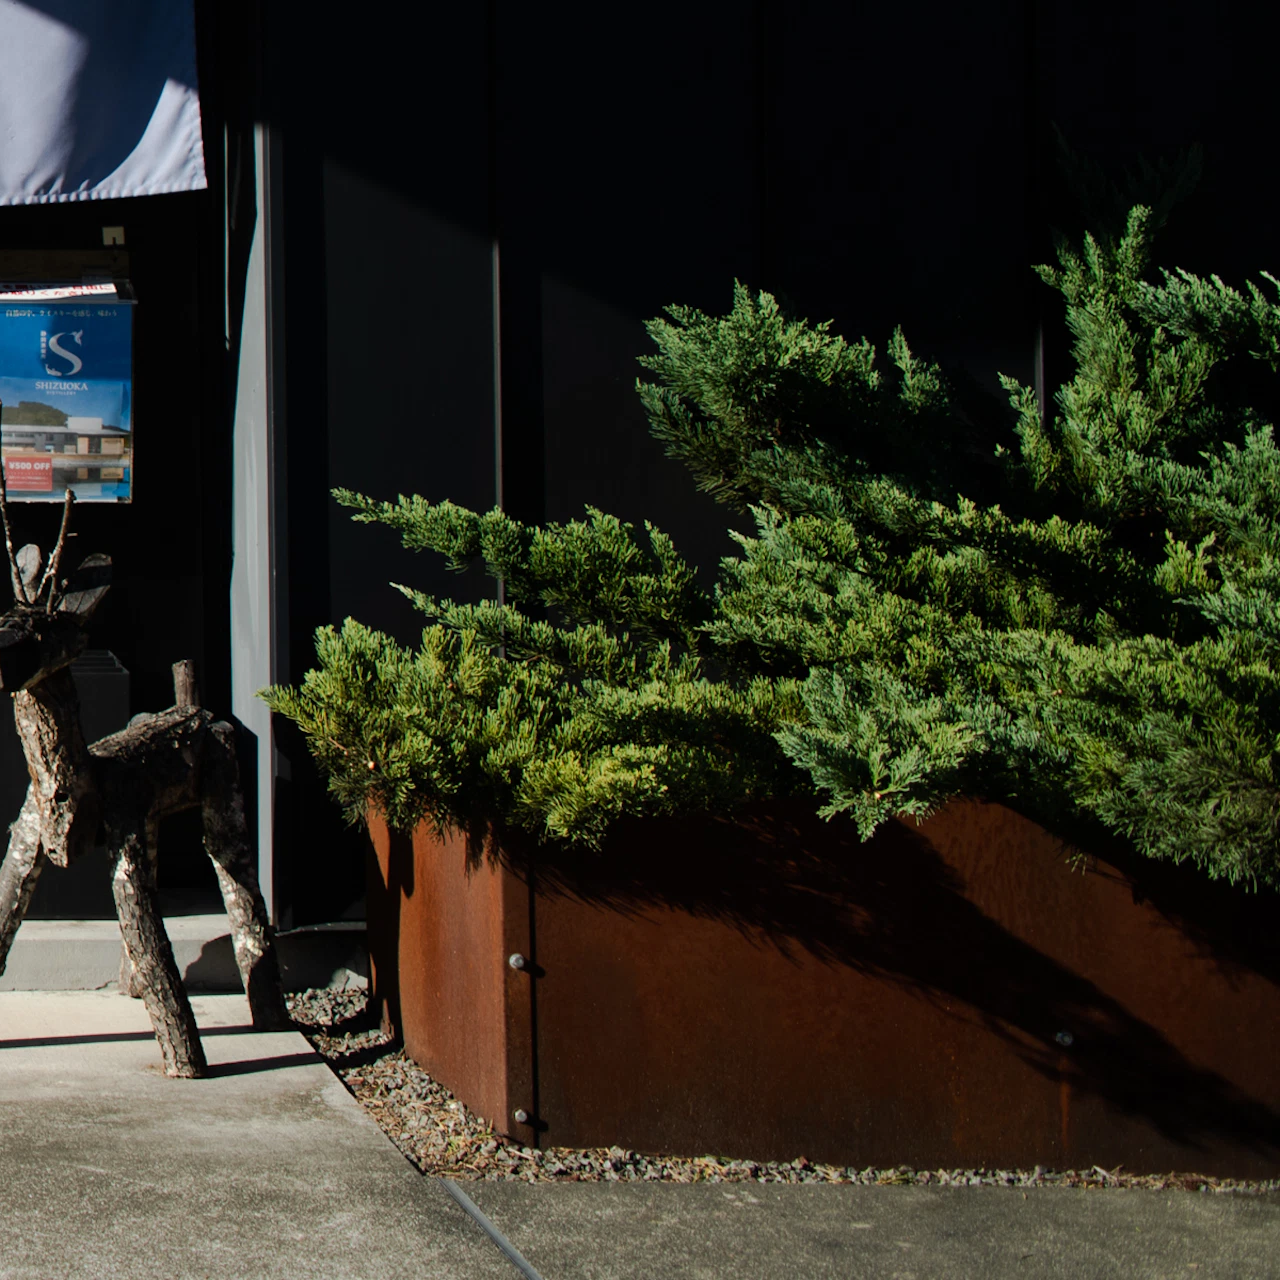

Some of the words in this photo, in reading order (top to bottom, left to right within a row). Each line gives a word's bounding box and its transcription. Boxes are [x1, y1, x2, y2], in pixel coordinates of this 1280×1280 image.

[35, 381, 88, 391] SHIZUOKA
[8, 462, 32, 470] ¥500
[33, 462, 50, 470] OFF
